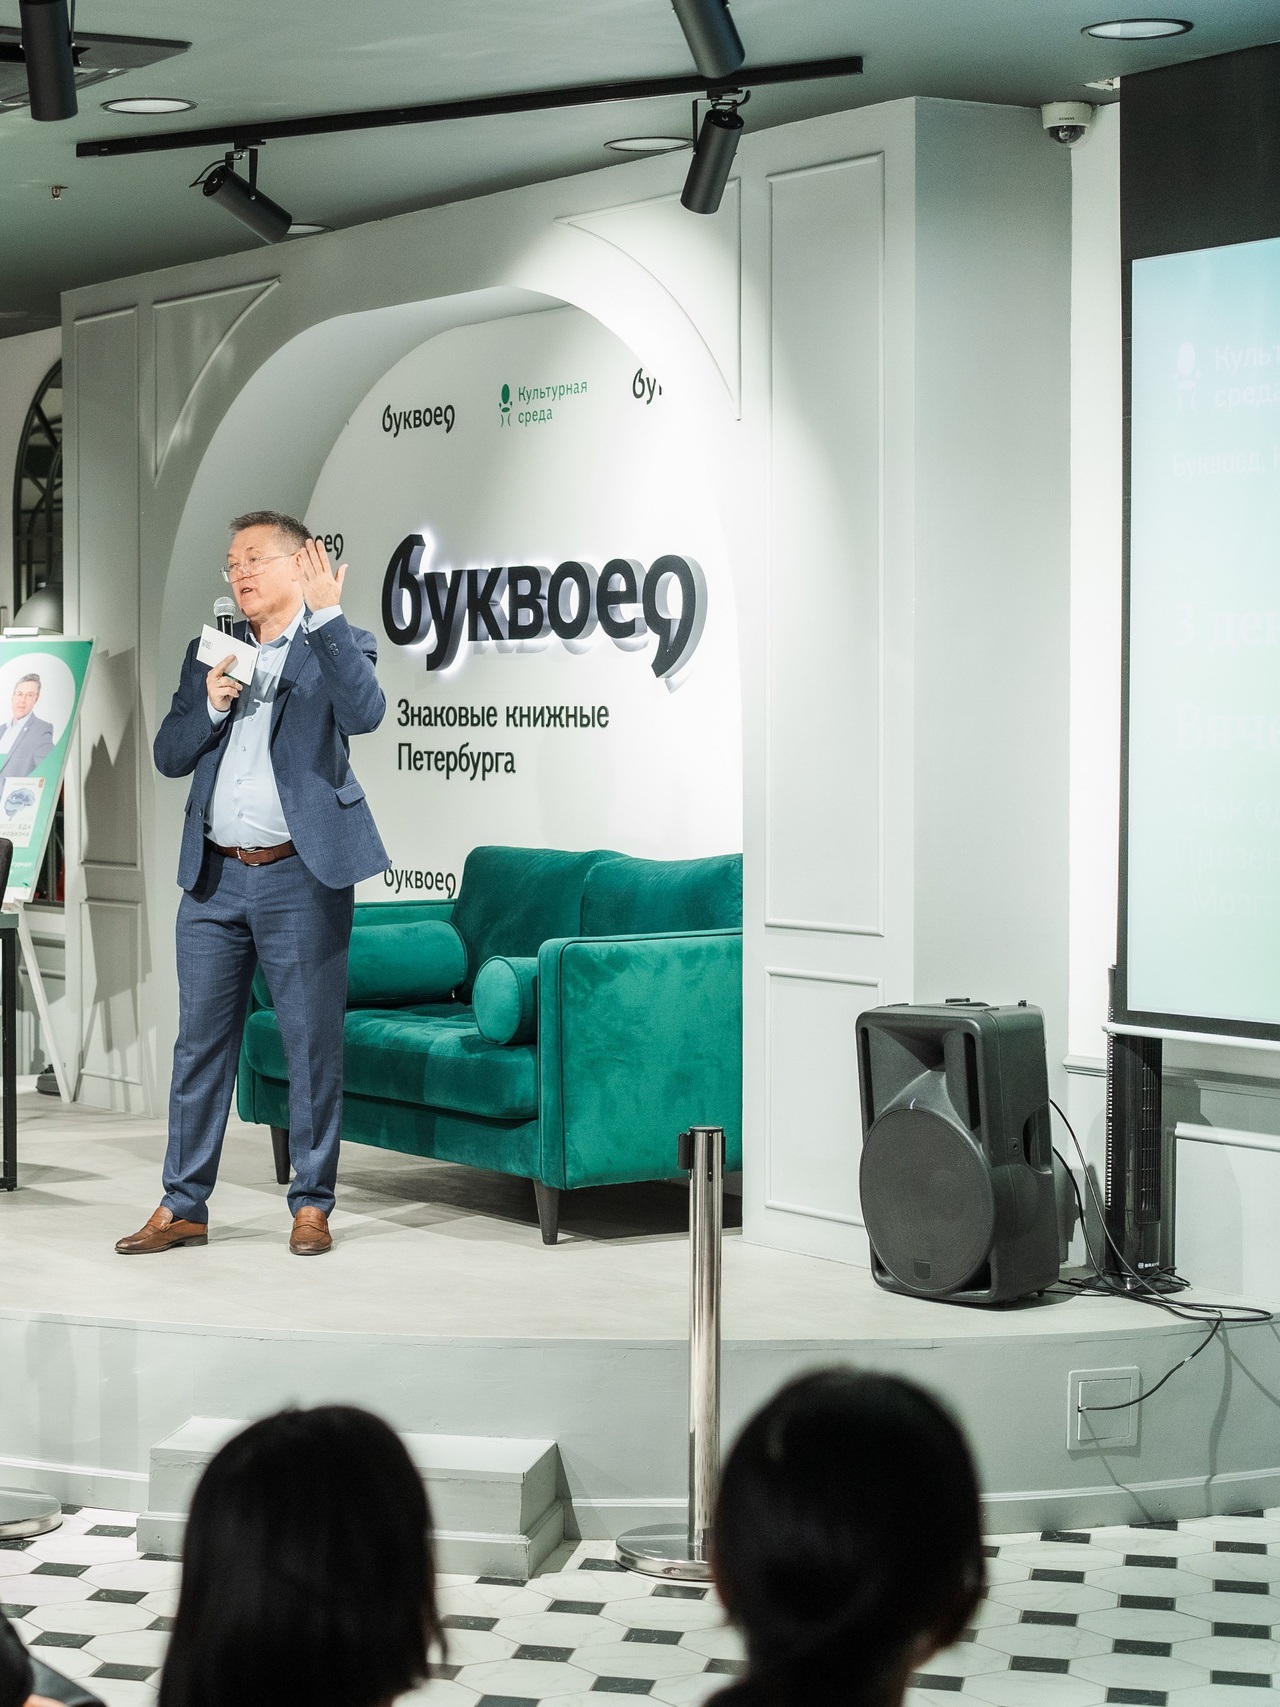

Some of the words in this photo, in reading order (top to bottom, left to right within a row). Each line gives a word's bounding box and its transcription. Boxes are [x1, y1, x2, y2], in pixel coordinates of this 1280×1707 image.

[518, 381, 588, 405] Культурная
[632, 367, 662, 405] бу
[382, 404, 455, 438] буквоед
[518, 408, 553, 427] среда
[381, 533, 708, 678] буквоед
[397, 698, 498, 727] Знаковые
[505, 705, 609, 728] книжные
[397, 742, 516, 781] Петербурга
[384, 860, 456, 899] буквоед
